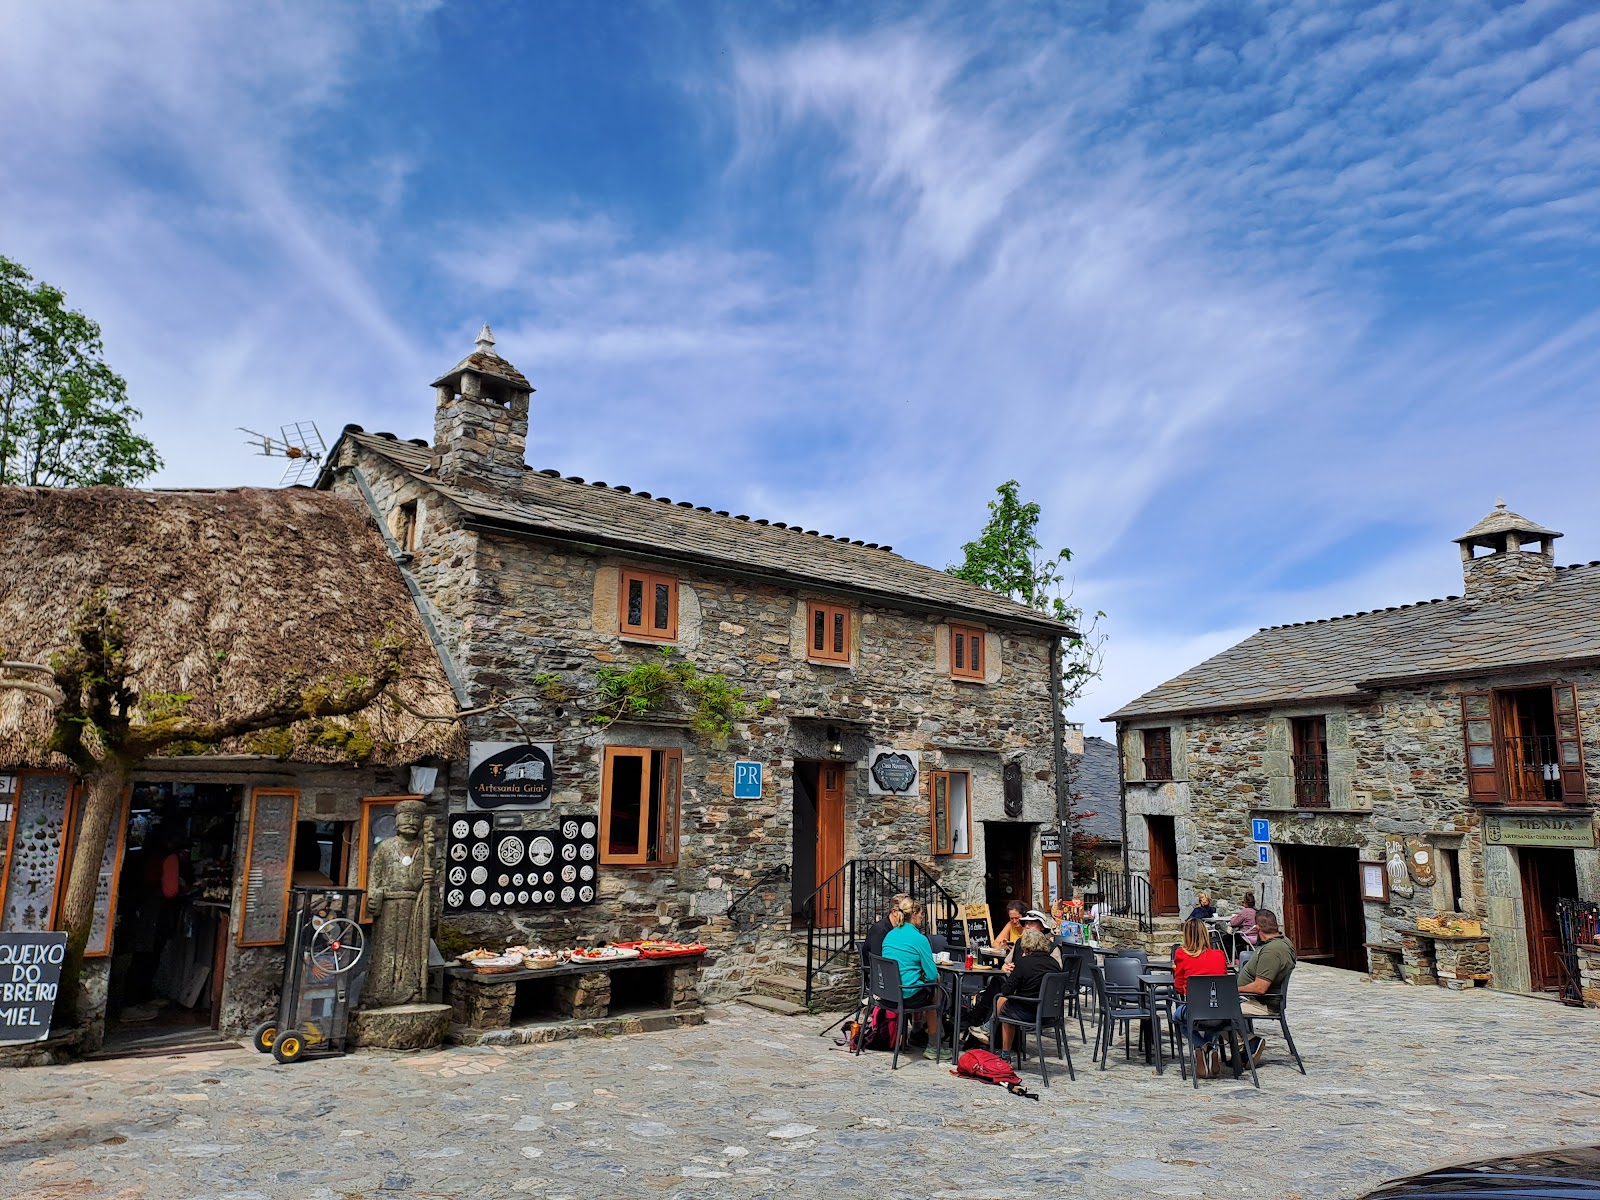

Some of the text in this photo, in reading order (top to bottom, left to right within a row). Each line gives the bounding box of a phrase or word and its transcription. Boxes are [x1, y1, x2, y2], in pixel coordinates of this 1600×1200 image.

[737, 765, 760, 785] PR
[523, 784, 544, 793] Grial
[1519, 819, 1574, 830] TIENDA
[0, 944, 65, 965] QUEIXO
[12, 964, 41, 983] DO
[0, 1006, 41, 1026] MIEL
